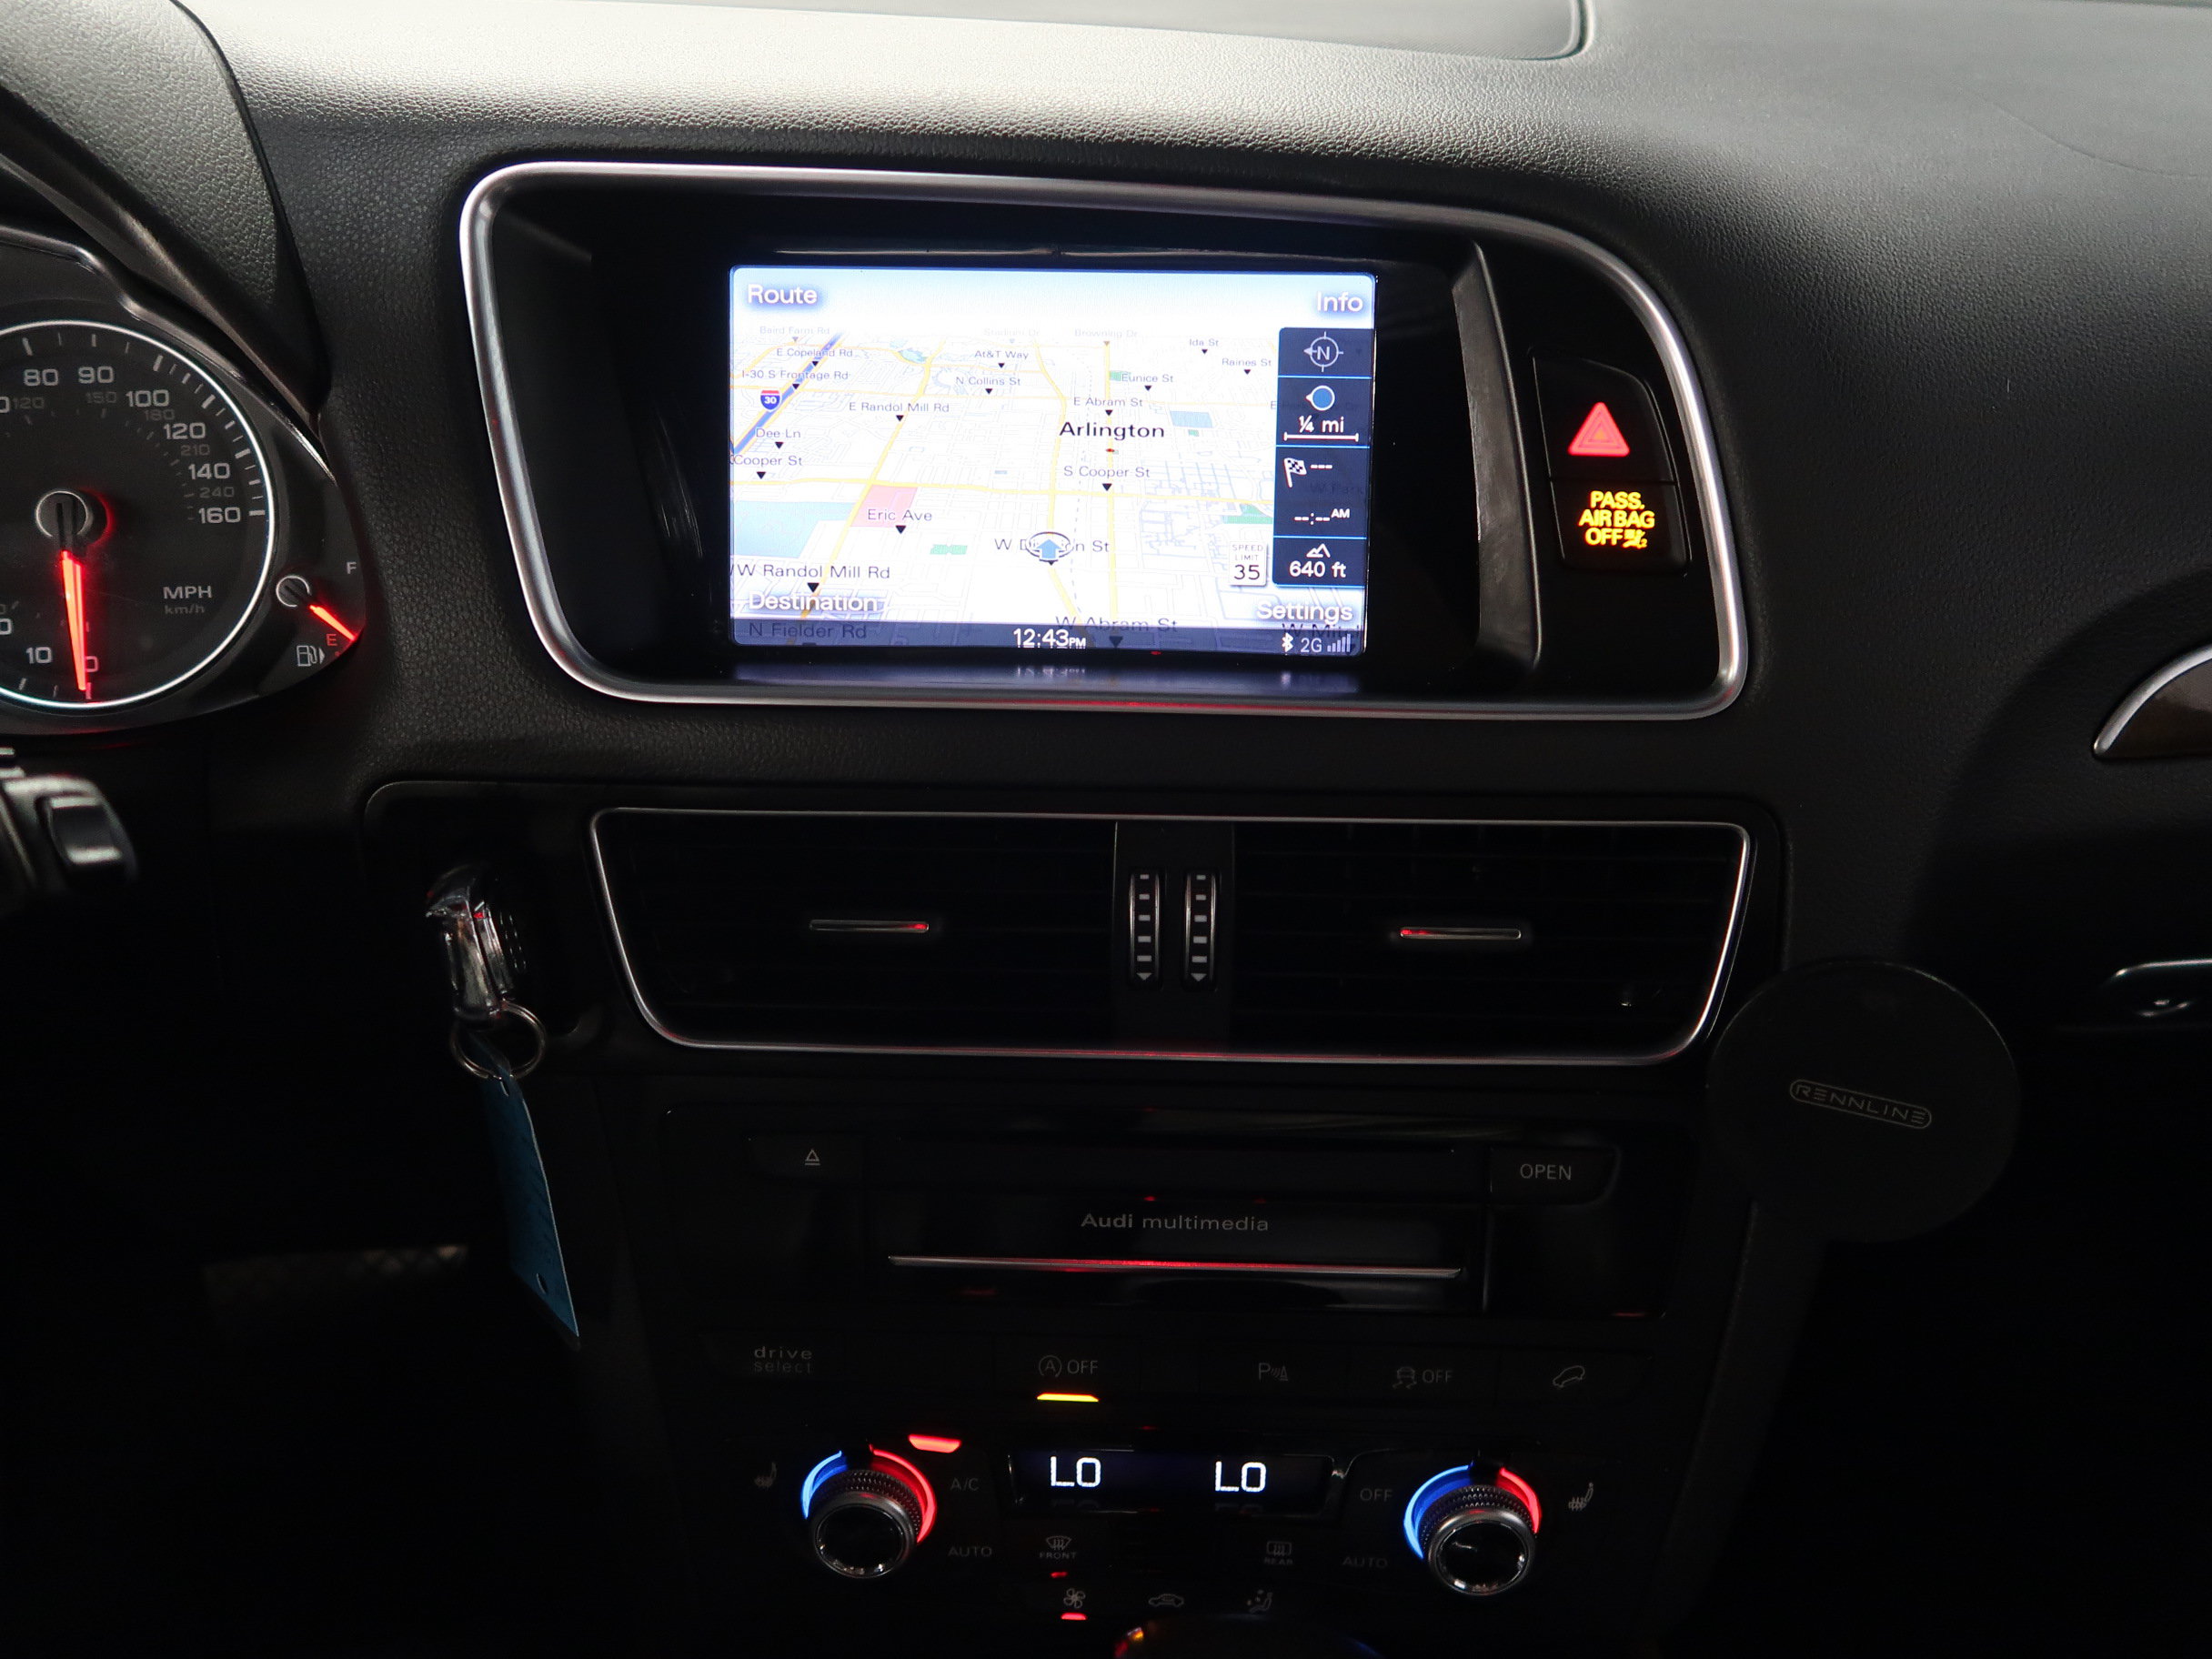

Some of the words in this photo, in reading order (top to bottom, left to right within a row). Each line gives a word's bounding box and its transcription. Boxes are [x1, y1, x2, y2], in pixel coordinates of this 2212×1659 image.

[748, 284, 818, 305] Route
[1317, 291, 1363, 312] Info
[818, 327, 830, 335] Rd
[1189, 338, 1204, 347] Ida
[1208, 338, 1219, 347] St
[776, 347, 784, 357] E
[786, 347, 835, 359] Copeland
[839, 348, 853, 357] Rd
[974, 350, 1002, 358] At&T
[1005, 350, 1029, 360] Way
[1222, 357, 1257, 367] Raines
[1261, 358, 1272, 367] St
[23, 367, 59, 387] 80
[77, 366, 115, 384] 90
[741, 369, 764, 378] I-30
[768, 369, 776, 378] S
[780, 370, 830, 380] Frontage
[834, 371, 849, 379] Rd
[956, 377, 964, 385] N
[968, 376, 1005, 386] Collins
[1009, 377, 1021, 386] St
[1121, 373, 1158, 383] Eunice
[1162, 374, 1173, 383] St
[13, 396, 45, 409] 120
[85, 391, 117, 404] 150
[126, 389, 170, 407] 100
[764, 397, 778, 405] 30
[1073, 397, 1081, 406] E
[1085, 397, 1126, 407] Abram
[1130, 397, 1142, 407] St
[849, 402, 856, 411] E
[860, 402, 903, 412] Randol
[907, 403, 929, 413] Mill
[933, 403, 950, 413] Rd
[163, 422, 207, 440] 120
[1059, 421, 1165, 441] Arlington
[1322, 416, 1344, 433] mi
[755, 428, 780, 438] Dee
[785, 428, 801, 438] Ln
[181, 443, 210, 456] 210
[734, 454, 783, 468] Cooper
[788, 455, 803, 467] St
[188, 462, 231, 480] 140
[1063, 465, 1073, 478] S
[1079, 465, 1130, 479] Cooper
[1135, 467, 1150, 478] St
[199, 486, 235, 498] 240
[1590, 490, 1645, 509] PASS.
[198, 507, 241, 524] 160
[868, 508, 896, 521] Eric
[901, 508, 932, 521] Ave
[1578, 508, 1613, 527] AIR
[1614, 510, 1655, 528] BAG
[1584, 528, 1624, 546] OFF
[994, 538, 1012, 550] W
[1091, 539, 1110, 553] St
[1232, 544, 1263, 552] SPEED
[1234, 554, 1259, 562] LIMIT
[347, 561, 357, 575] F
[737, 563, 756, 577] W
[763, 564, 822, 578] Randol
[830, 565, 860, 578] Mill
[868, 566, 890, 579] Rd
[1233, 564, 1261, 580] 35
[1289, 560, 1325, 578] 640
[1332, 561, 1347, 578] ft
[164, 585, 212, 599] MPH
[165, 602, 206, 615] km/h
[748, 591, 878, 612] Destination
[1256, 600, 1353, 625] Settings
[749, 622, 763, 637] N
[771, 622, 834, 638] Fielder
[842, 624, 867, 638] Rd
[1055, 616, 1077, 630] W
[1086, 617, 1149, 631] Abram
[1158, 618, 1179, 633] St
[326, 633, 337, 647] E
[1300, 637, 1322, 653] 2G
[25, 646, 53, 664] 10
[1795, 1083, 1928, 1125] RENNLINE
[1519, 1163, 1573, 1181] OPEN
[1081, 1212, 1134, 1230] Audi
[1141, 1213, 1269, 1232] multimedia
[753, 1345, 813, 1361] drive
[1066, 1359, 1099, 1375] OFF
[1422, 1369, 1453, 1384] OFF
[1049, 1455, 1102, 1488] LO
[1213, 1460, 1267, 1493] LO
[950, 1476, 980, 1493] A/C
[1359, 1487, 1393, 1503] OFF
[947, 1544, 993, 1558] AUTO
[1039, 1551, 1077, 1561] FRONT
[1341, 1554, 1389, 1570] AUTO
